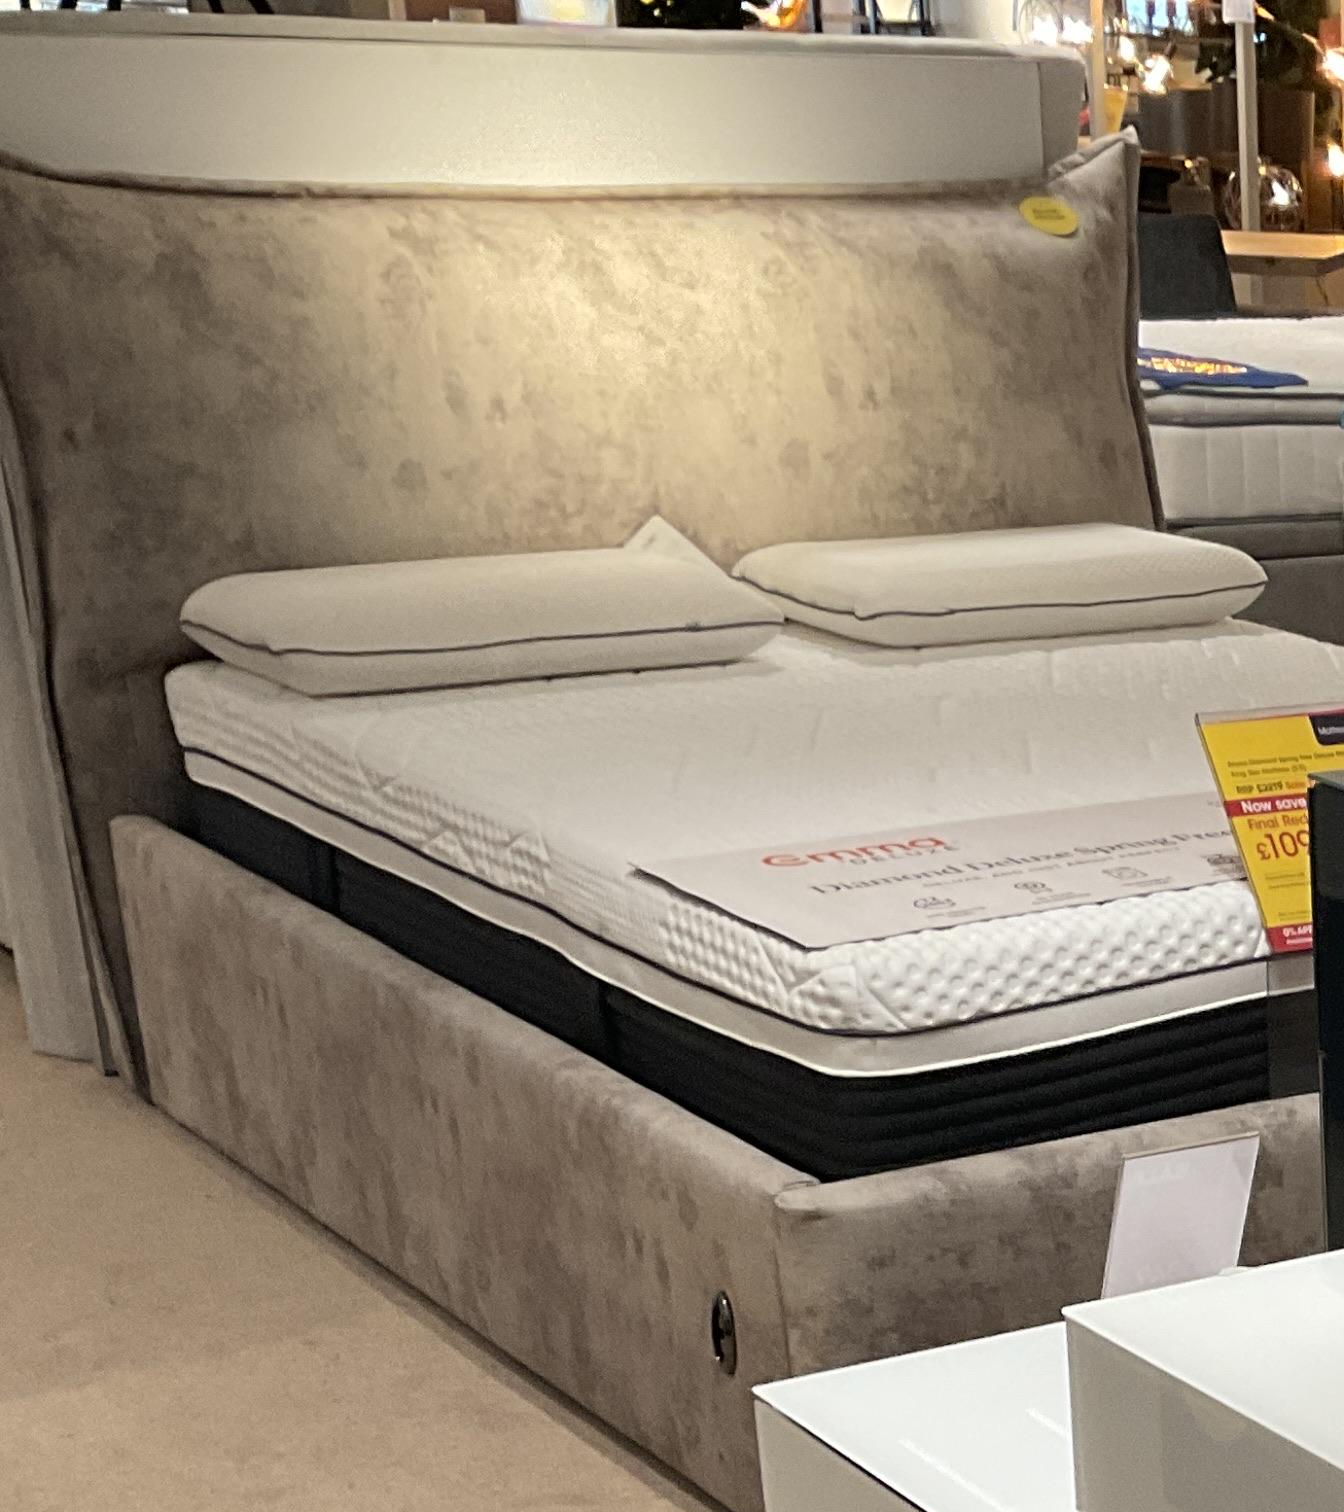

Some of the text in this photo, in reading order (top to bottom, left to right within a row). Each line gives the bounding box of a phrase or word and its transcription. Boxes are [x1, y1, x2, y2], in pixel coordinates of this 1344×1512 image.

[1240, 797, 1307, 814] Now save
[1247, 815, 1280, 831] Final
[761, 836, 947, 868] emma
[809, 863, 964, 895] Diamond
